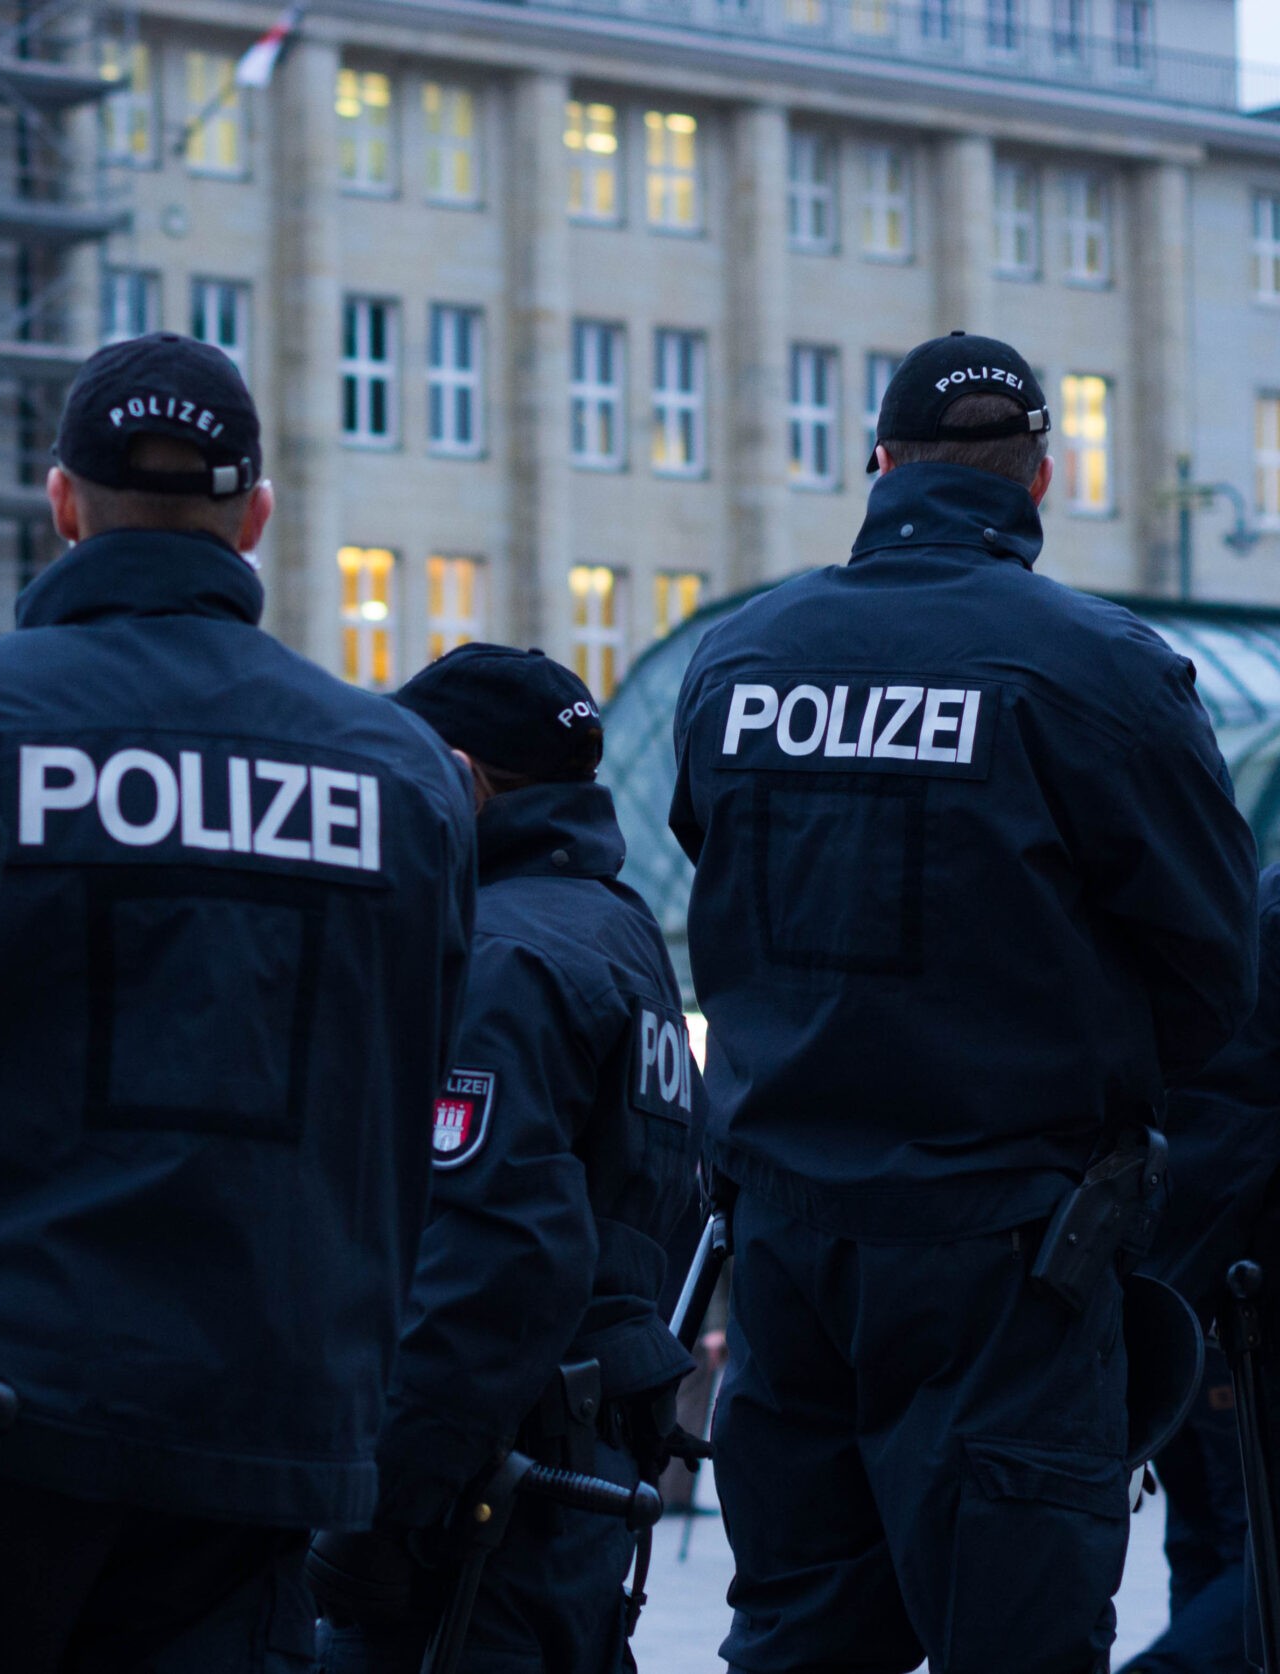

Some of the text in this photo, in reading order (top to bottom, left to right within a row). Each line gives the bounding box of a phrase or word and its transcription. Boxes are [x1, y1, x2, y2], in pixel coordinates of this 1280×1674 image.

[935, 366, 1024, 393] POLIZEI
[109, 396, 225, 439] POLIZEI
[722, 683, 982, 764] POLIZEI
[18, 744, 382, 872] POLIZEI
